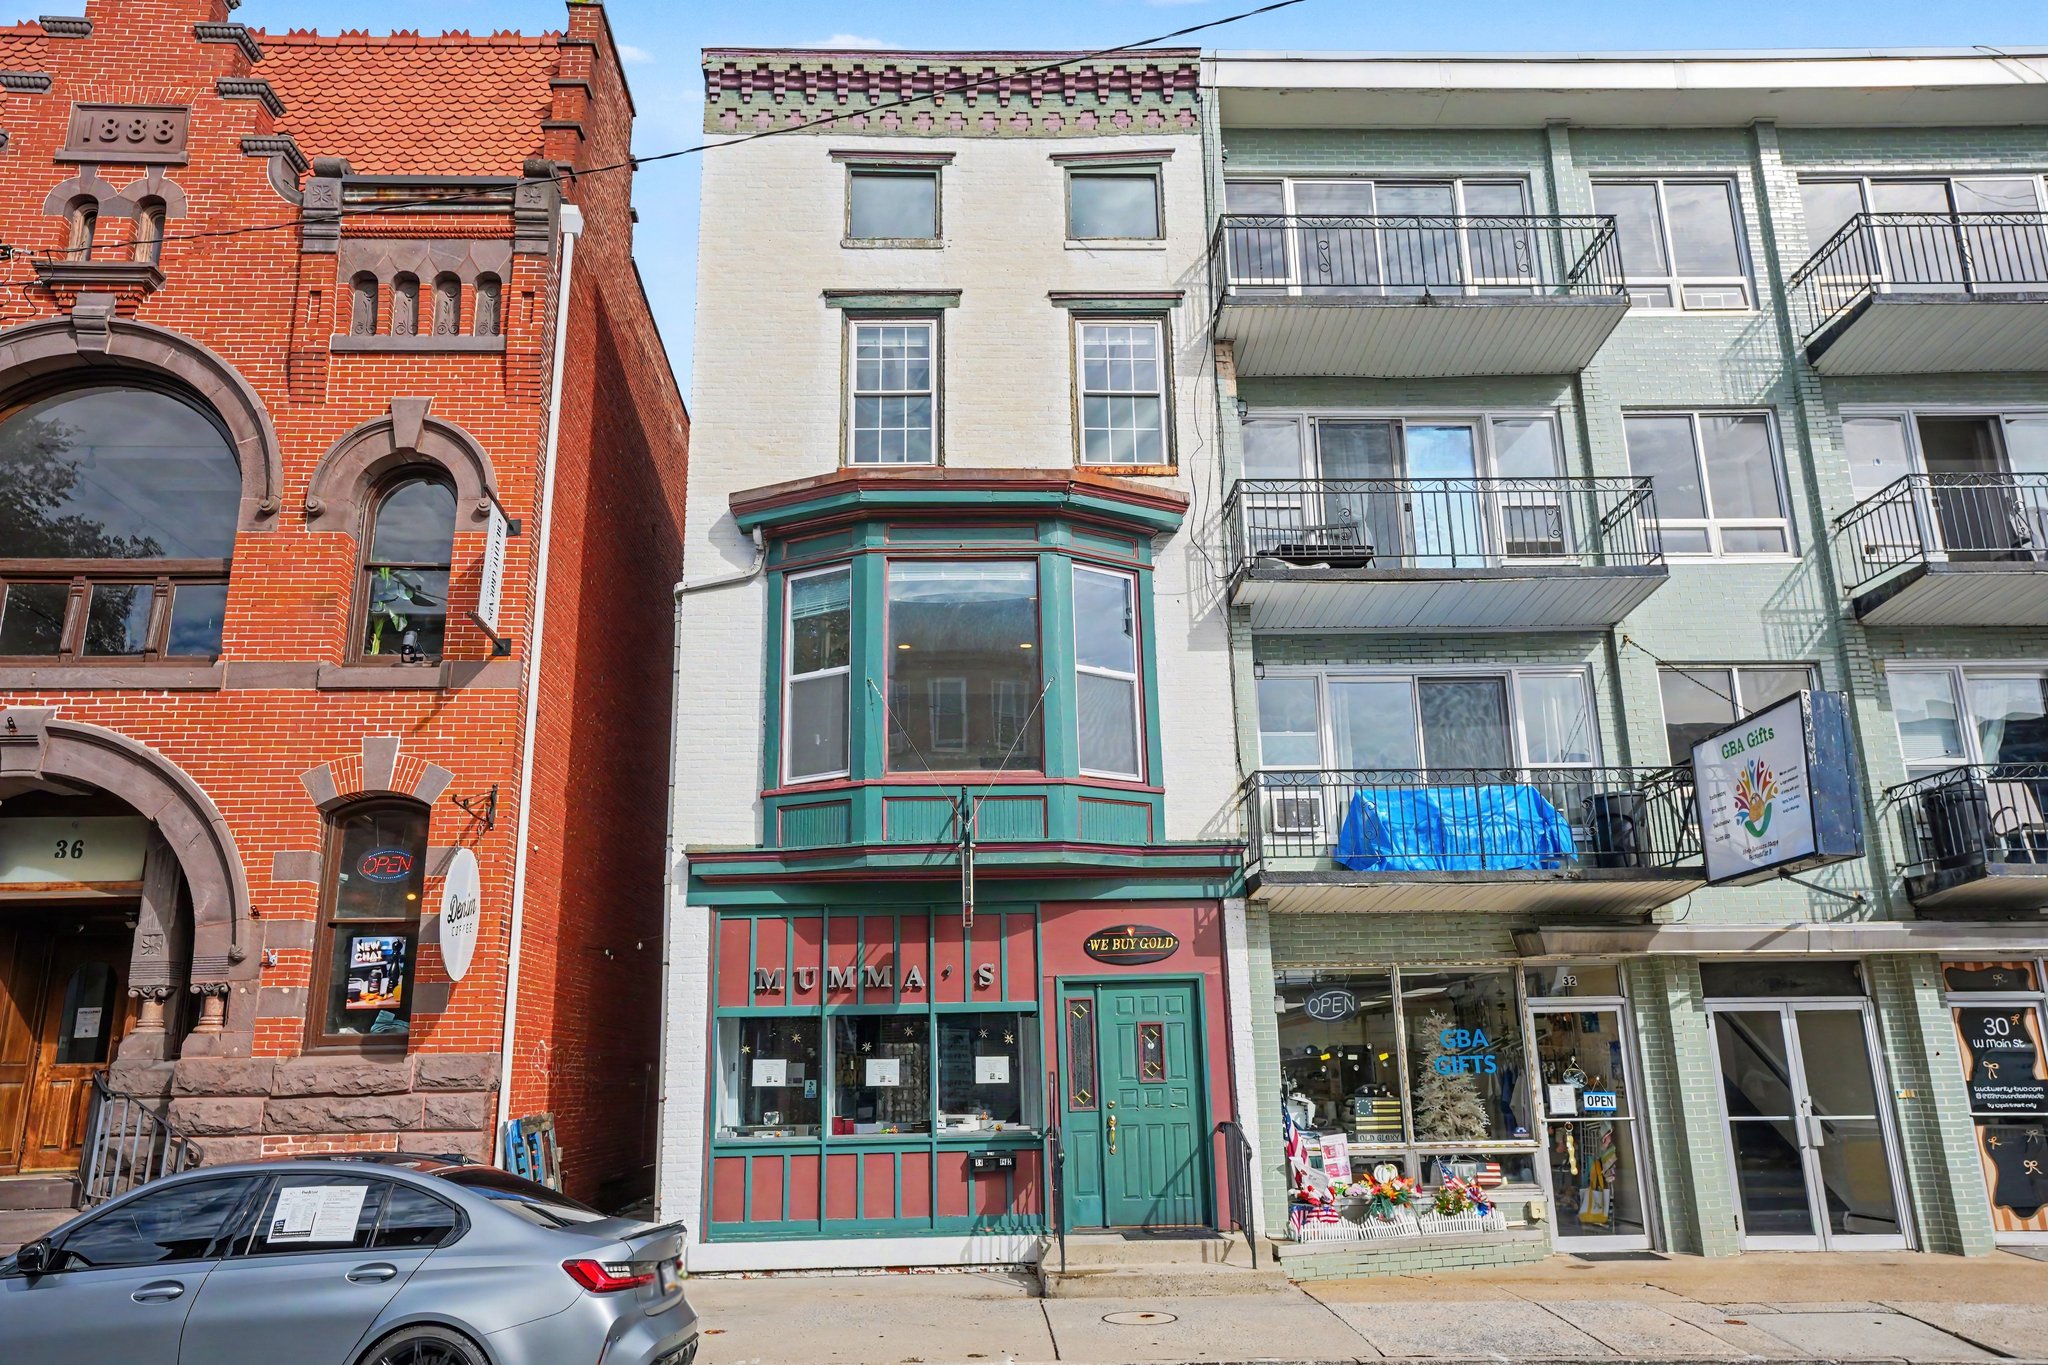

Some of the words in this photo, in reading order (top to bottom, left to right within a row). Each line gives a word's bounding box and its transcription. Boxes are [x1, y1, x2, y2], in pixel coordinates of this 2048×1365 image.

[82, 117, 176, 144] 1888
[1721, 738, 1745, 760] GBA
[1746, 726, 1775, 749] Gifts
[54, 840, 84, 859] 36
[362, 855, 415, 875] OPEN
[447, 893, 477, 924] Denim
[451, 923, 473, 936] COFFEE
[356, 940, 381, 952] NEW
[1089, 939, 1109, 951] WE
[1112, 938, 1137, 950] BUY
[1139, 937, 1174, 949] GOLD
[354, 950, 383, 962] CHAI
[755, 962, 996, 991] MUMMA'S
[1563, 976, 1576, 986] 32
[1308, 995, 1355, 1015] OPEN
[1983, 1017, 2010, 1036] 30
[1440, 1028, 1489, 1049] GBA
[1973, 1039, 1984, 1048] W
[1986, 1038, 2011, 1048] Main
[2013, 1038, 2025, 1048] St
[1434, 1054, 1497, 1075] GIFTS
[1587, 1095, 1614, 1107] OPEN
[1360, 1133, 1375, 1141] OLD
[1377, 1133, 1400, 1141] GLORY
